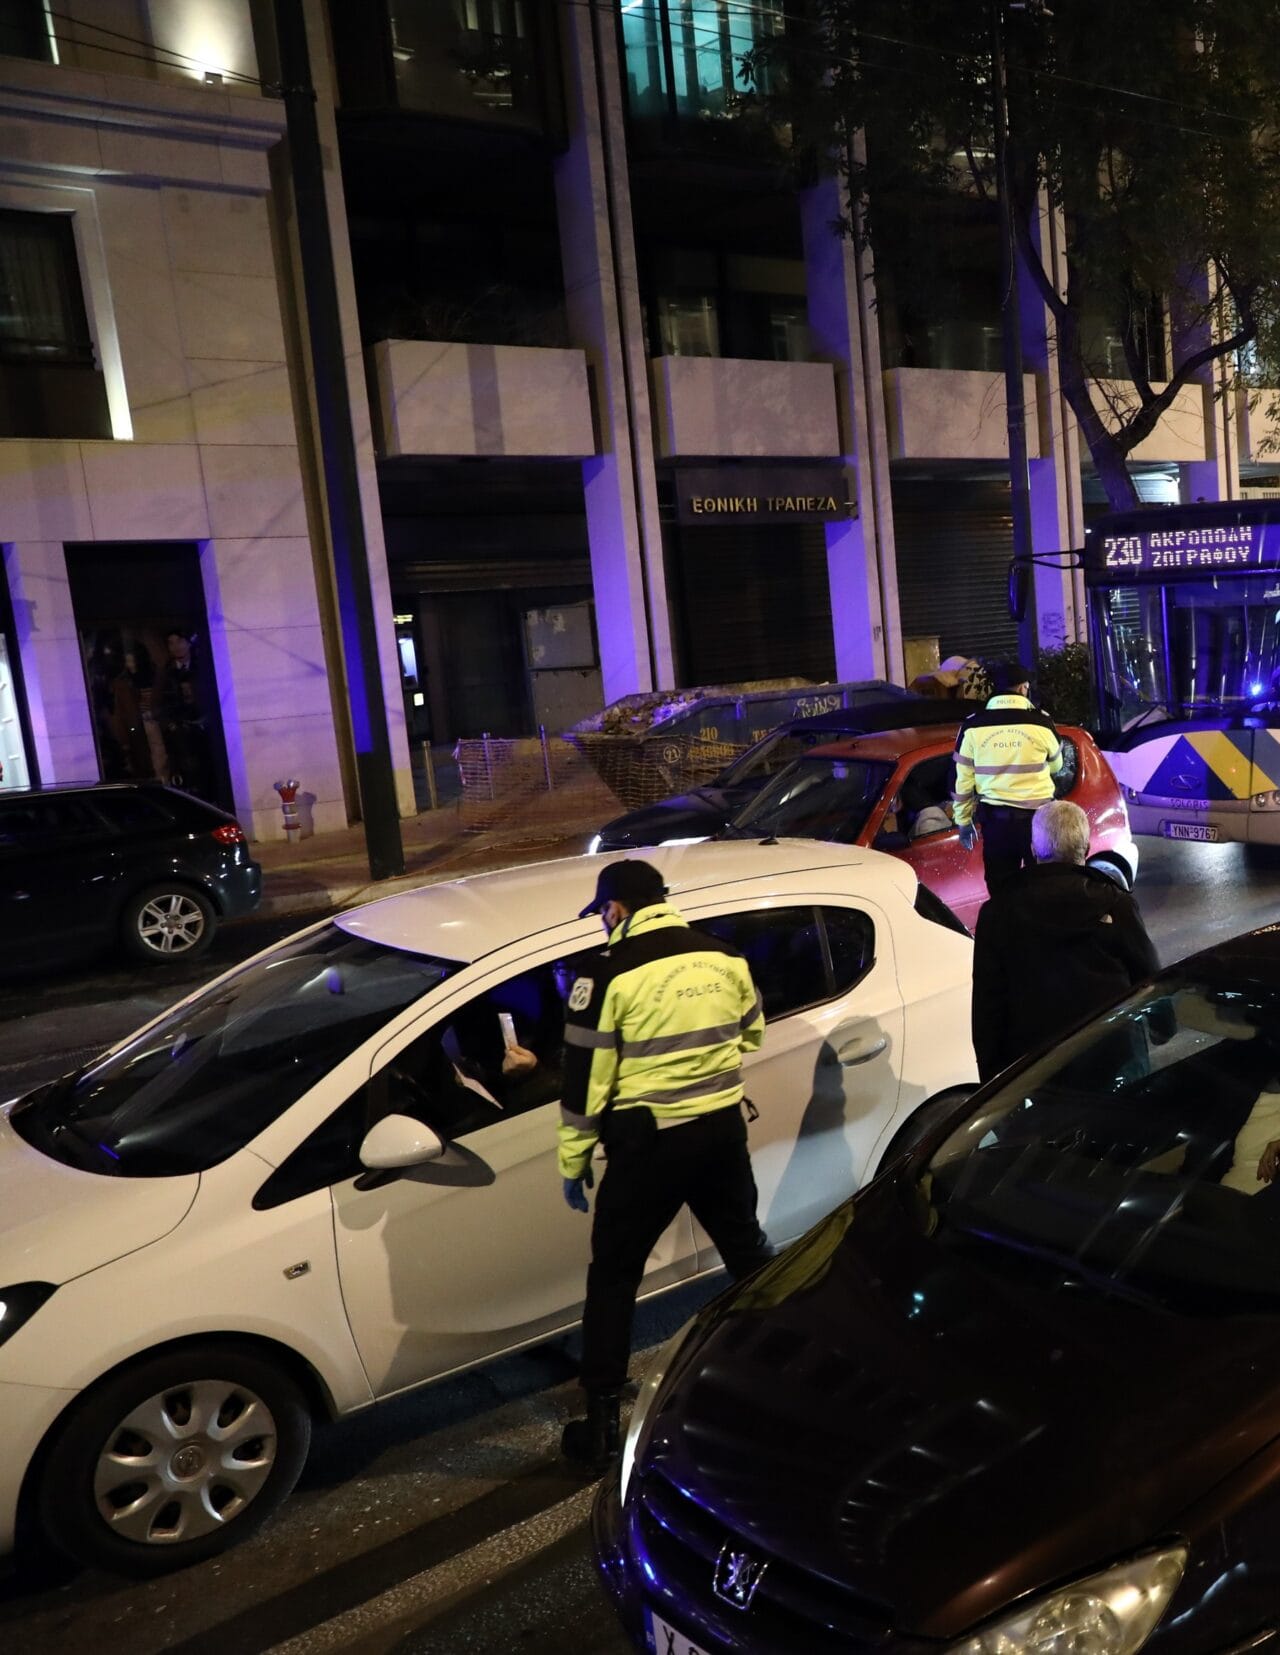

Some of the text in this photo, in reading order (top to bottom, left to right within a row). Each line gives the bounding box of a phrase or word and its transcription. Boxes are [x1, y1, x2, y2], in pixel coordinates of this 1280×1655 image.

[692, 496, 837, 513] ΕΘΝΙΚΗ ΤΡΑΠΕΖΑ
[1150, 526, 1253, 548] ΑΚΡΟΠΟΛΗ
[1104, 536, 1143, 567] 230
[1151, 546, 1251, 567] ΖΩΓΡΑΦΟΥ
[676, 981, 723, 1000] POLICE
